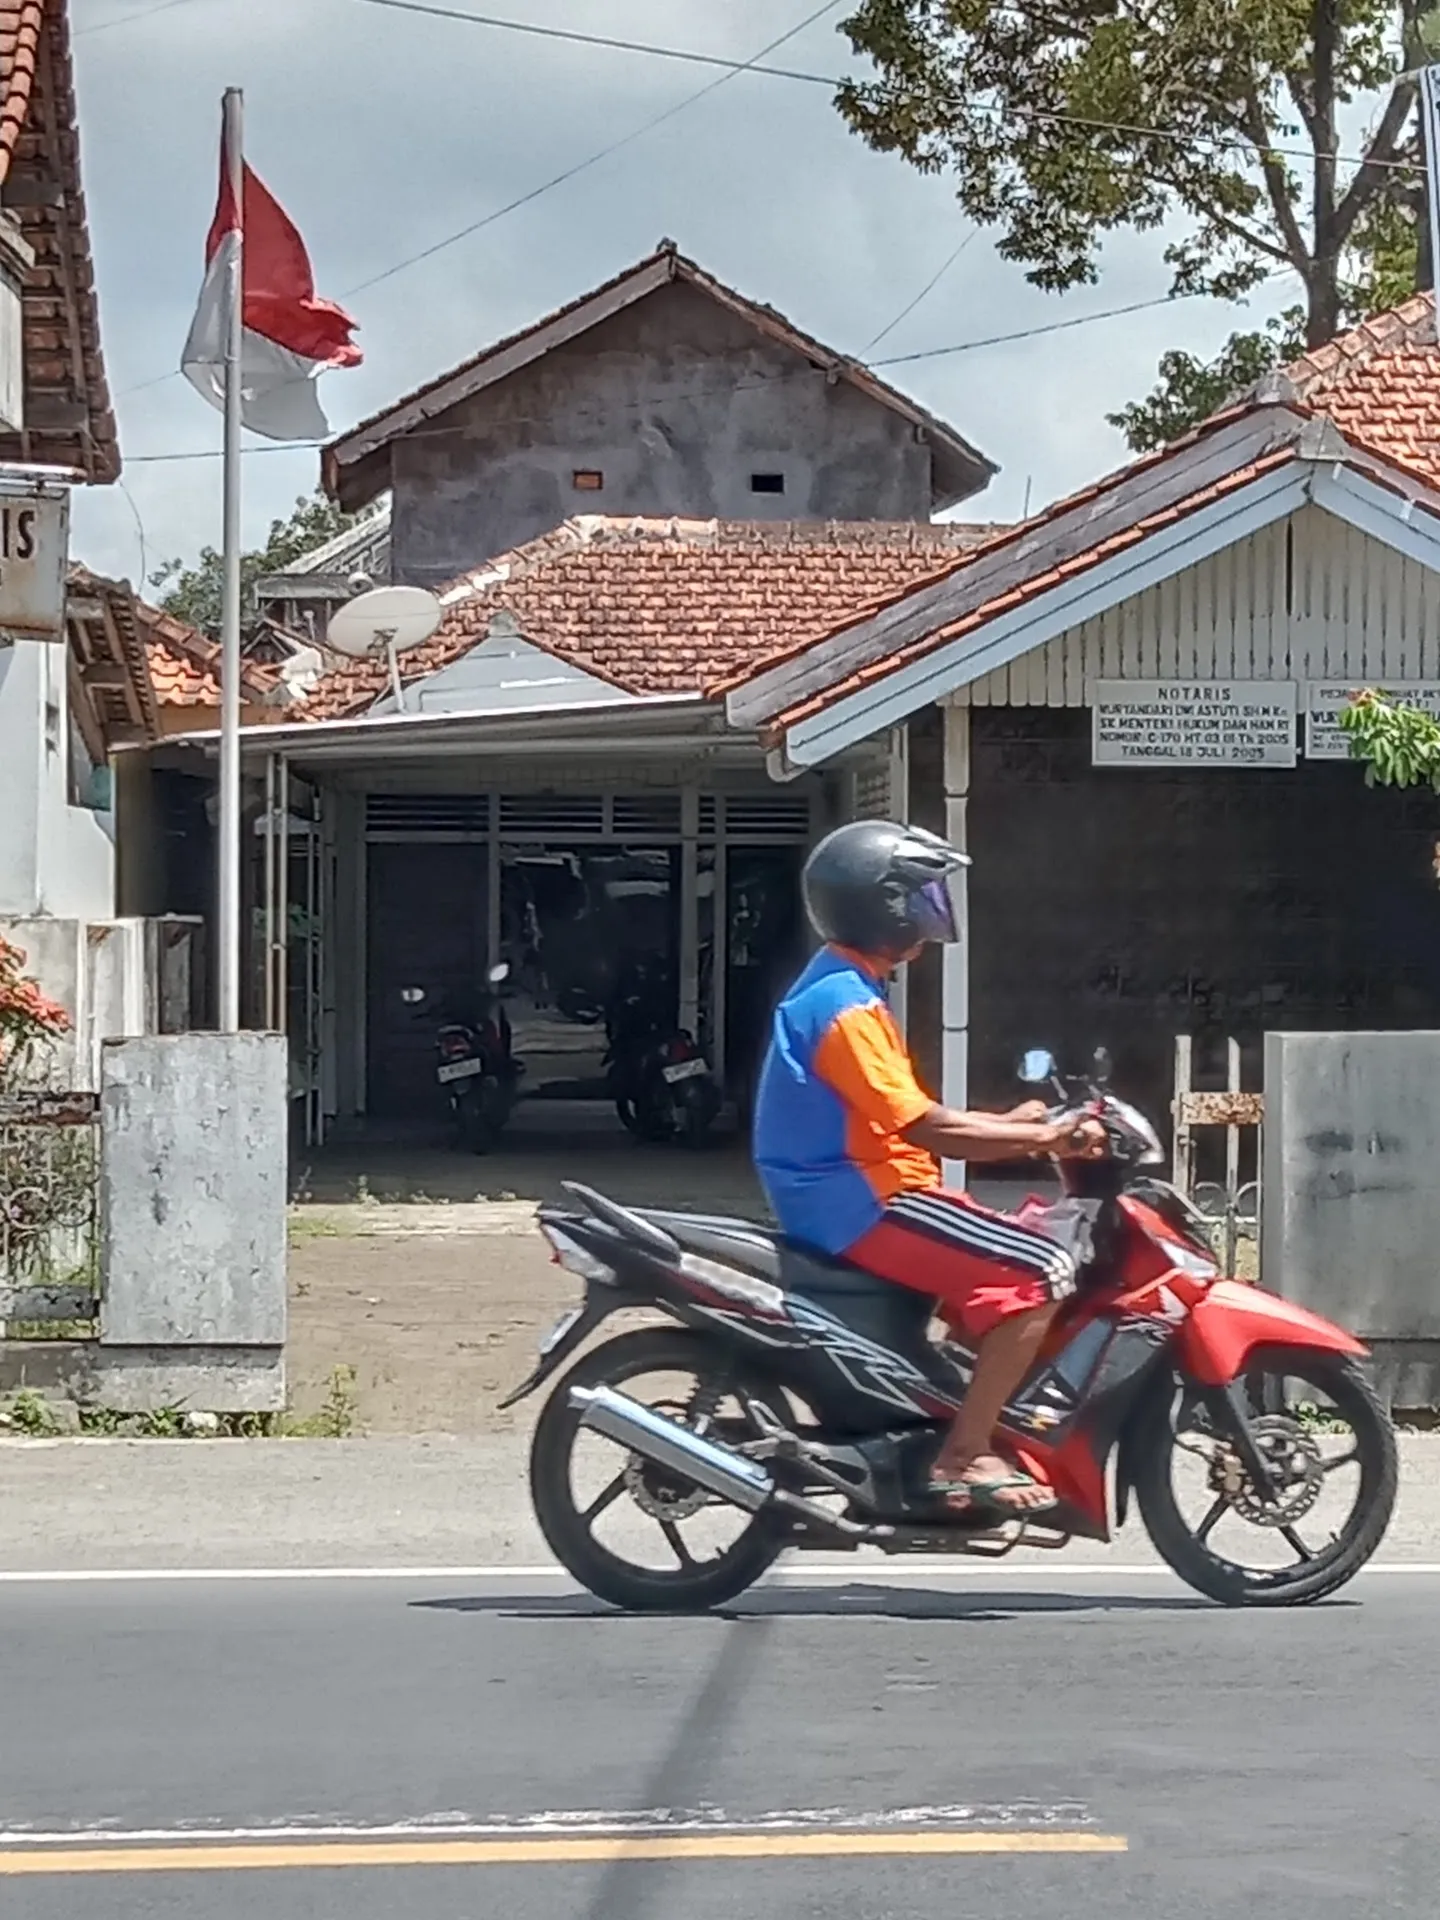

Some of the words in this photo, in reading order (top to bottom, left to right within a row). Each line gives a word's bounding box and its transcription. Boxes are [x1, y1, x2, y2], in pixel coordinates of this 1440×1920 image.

[1158, 688, 1231, 700] NOTARIS
[1197, 705, 1239, 716] ASTUTI
[1119, 718, 1173, 729] MENTERI
[1223, 719, 1247, 730] DAN
[1121, 745, 1177, 757] TANGGAL
[1197, 747, 1225, 758] JULI
